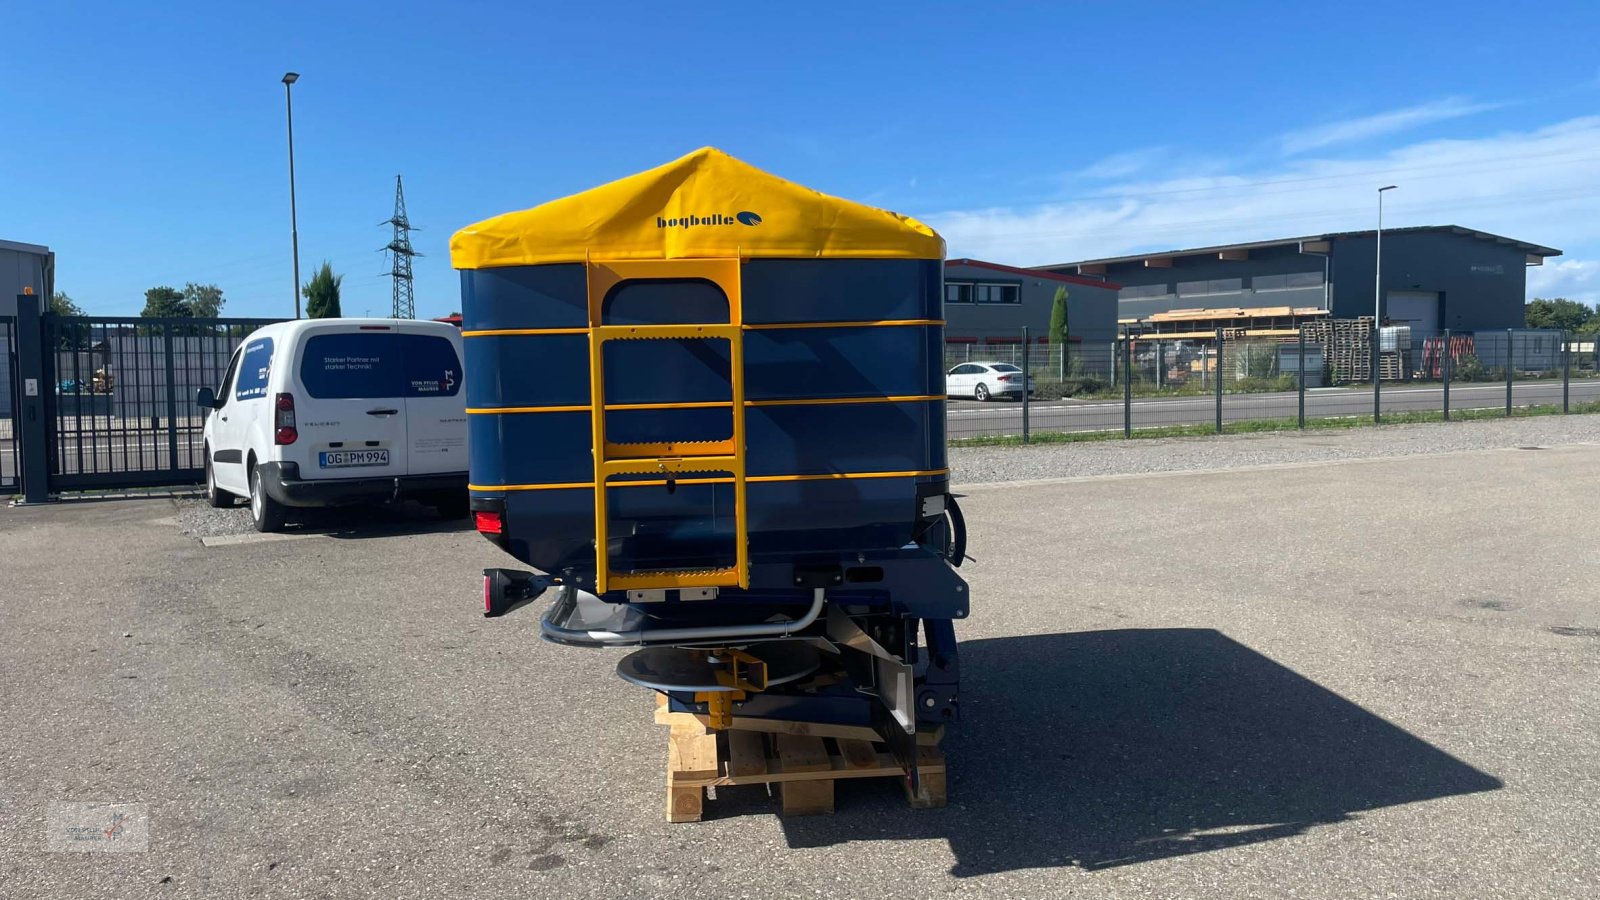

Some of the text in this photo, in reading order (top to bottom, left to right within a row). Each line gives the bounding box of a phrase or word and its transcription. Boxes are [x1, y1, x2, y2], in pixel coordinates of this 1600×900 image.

[327, 452, 387, 464] OG PM 994
